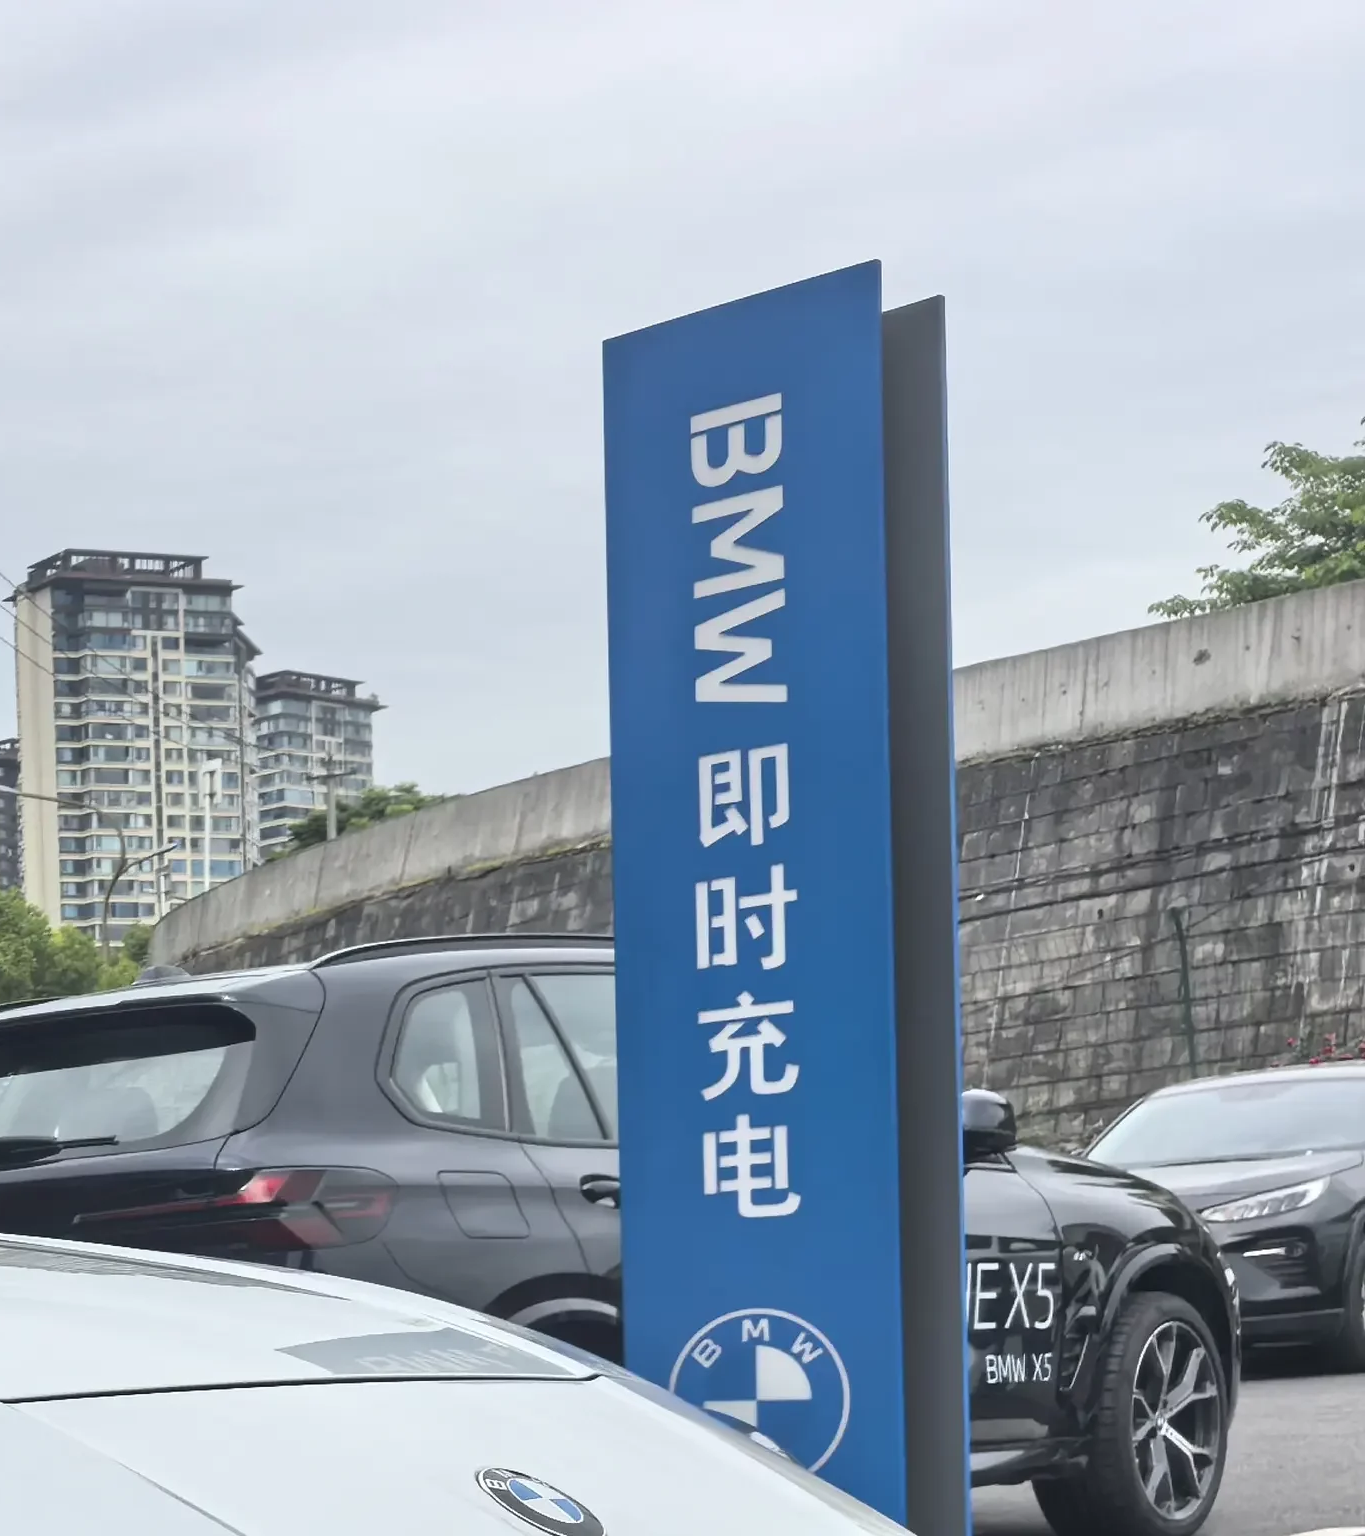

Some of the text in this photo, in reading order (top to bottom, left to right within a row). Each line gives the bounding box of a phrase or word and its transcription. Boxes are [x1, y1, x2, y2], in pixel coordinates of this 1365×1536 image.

[690, 392, 801, 1218] BMW 即时充电
[966, 1262, 1056, 1330] E X5
[690, 1317, 824, 1369] BMW
[985, 1352, 1053, 1384] BMW X5
